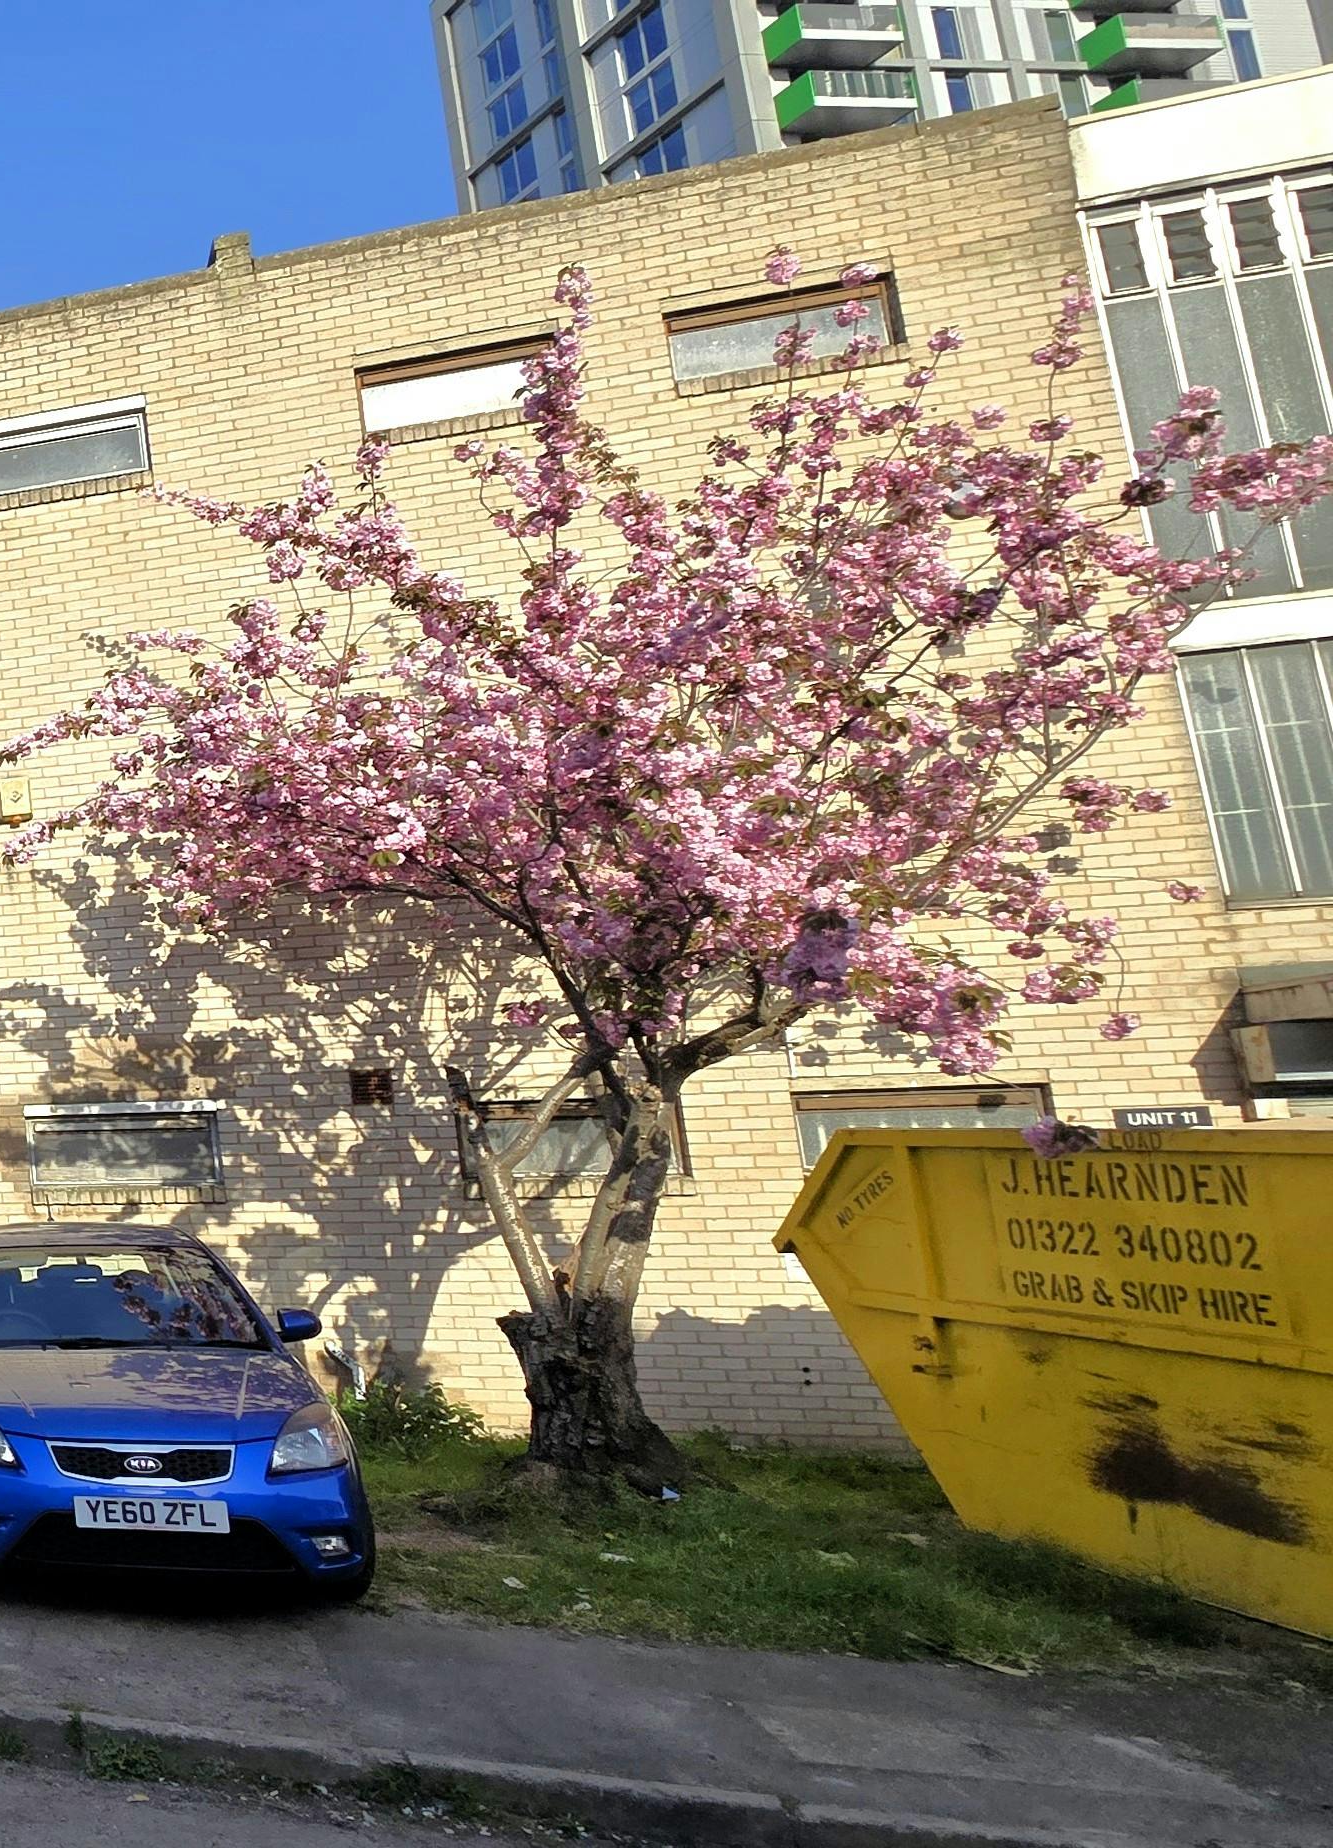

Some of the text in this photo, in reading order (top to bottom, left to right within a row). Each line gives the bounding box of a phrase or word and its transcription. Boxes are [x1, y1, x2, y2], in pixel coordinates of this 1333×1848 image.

[1126, 1111, 1199, 1126] UNIT 11
[835, 1169, 895, 1229] NO TYRES
[1007, 1217, 1263, 1272] 01322 340802
[1013, 1269, 1278, 1328] GRAB & SKIP HIRE
[129, 1459, 157, 1470] KIA
[85, 1500, 217, 1527] YE60 ZFL
